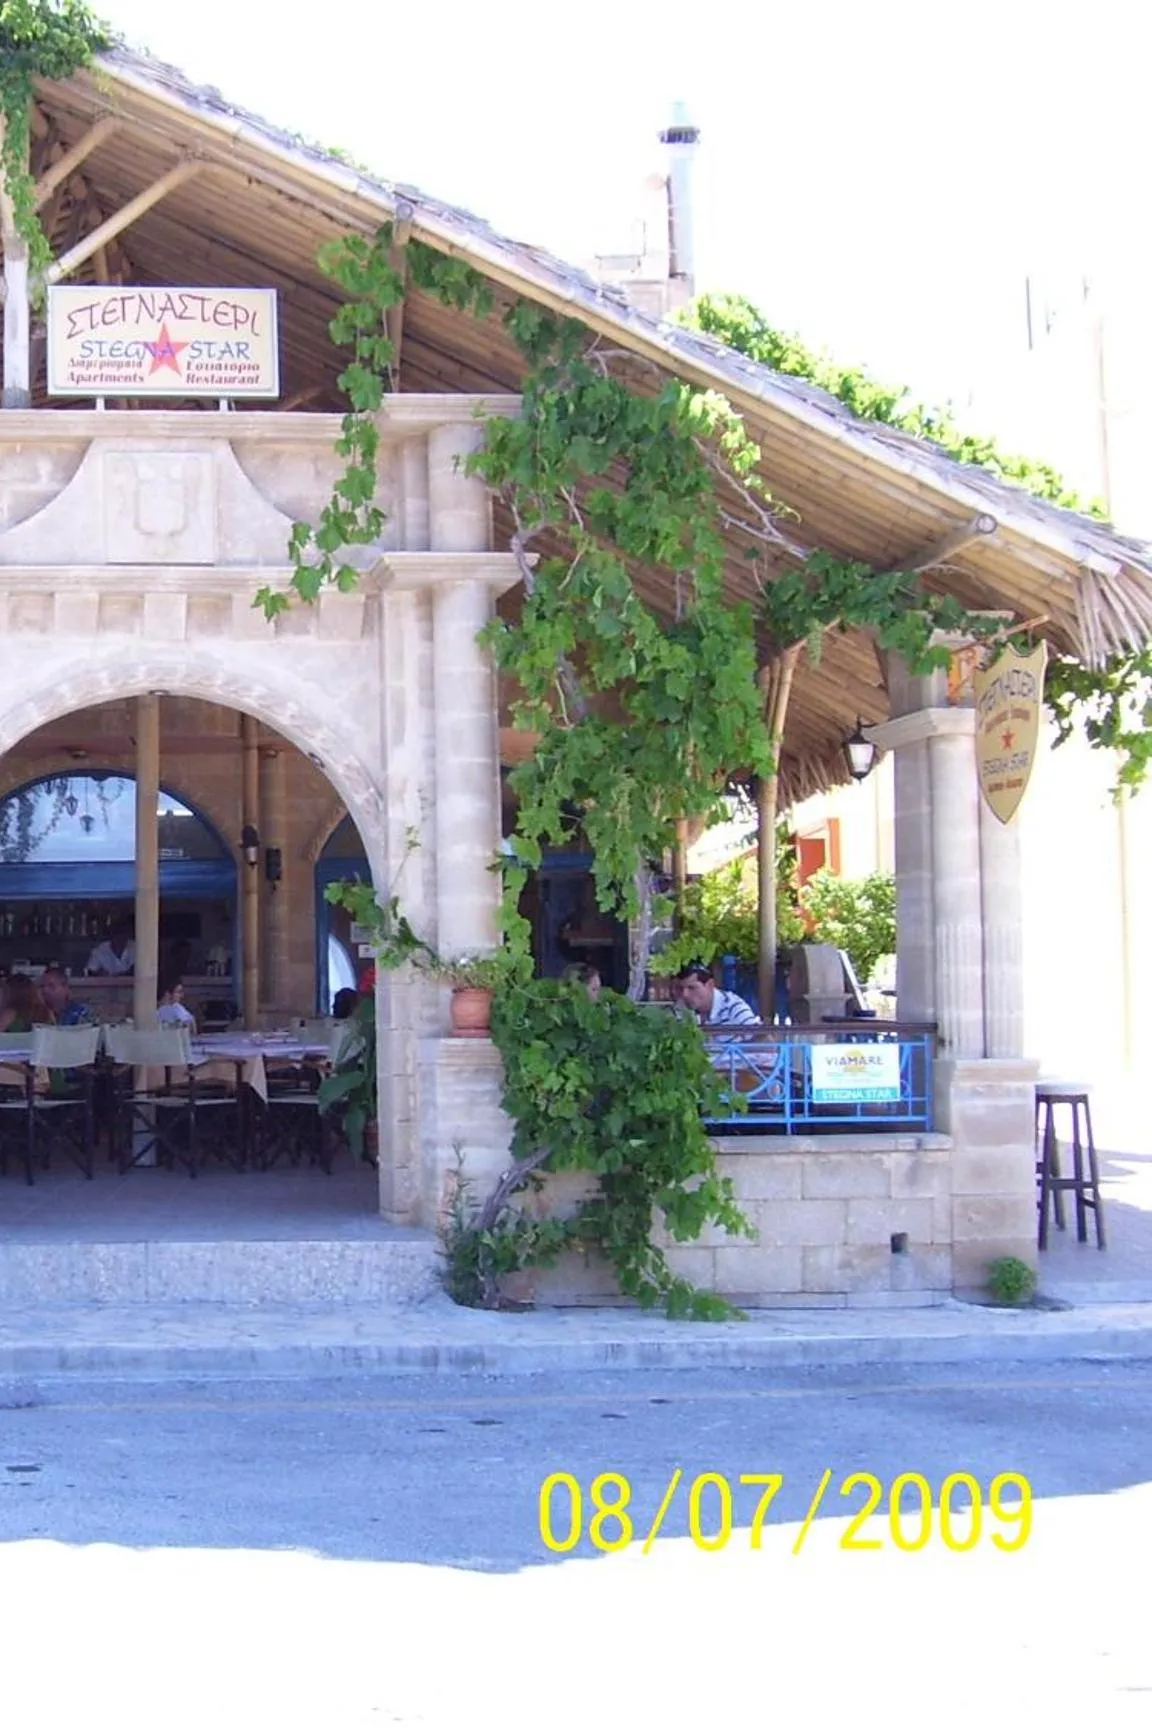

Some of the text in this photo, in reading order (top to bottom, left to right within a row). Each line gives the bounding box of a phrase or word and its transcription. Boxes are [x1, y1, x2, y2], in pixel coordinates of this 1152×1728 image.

[79, 340, 252, 361] STEGNA STAR
[67, 371, 145, 385] Apartments
[186, 372, 260, 384] Restaurant
